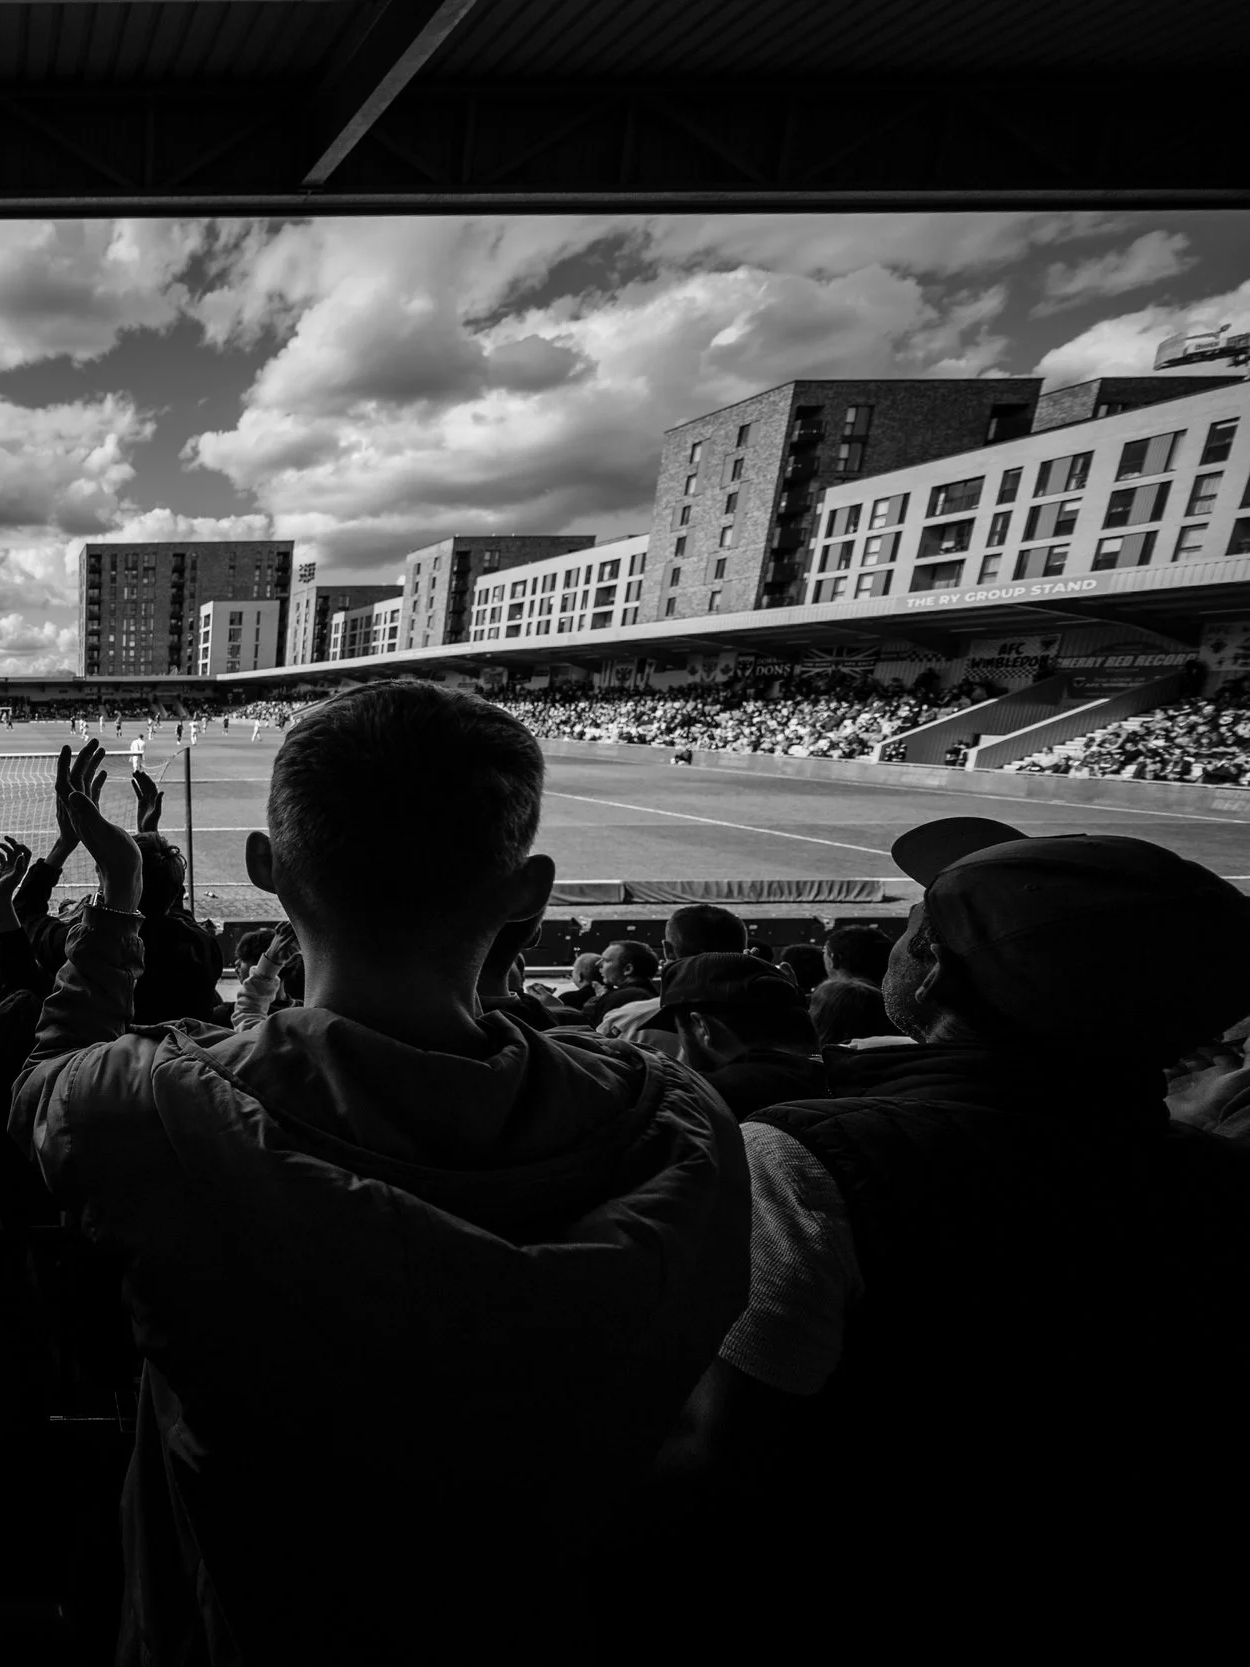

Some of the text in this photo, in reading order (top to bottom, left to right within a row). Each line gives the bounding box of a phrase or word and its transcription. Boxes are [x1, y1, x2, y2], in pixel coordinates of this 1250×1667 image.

[907, 579, 1098, 608] THE RY GROUP STAND
[998, 642, 1026, 656] AFC
[971, 655, 1050, 669] WIMBLEDON
[1104, 655, 1135, 667] RED
[755, 663, 792, 678] DONS
